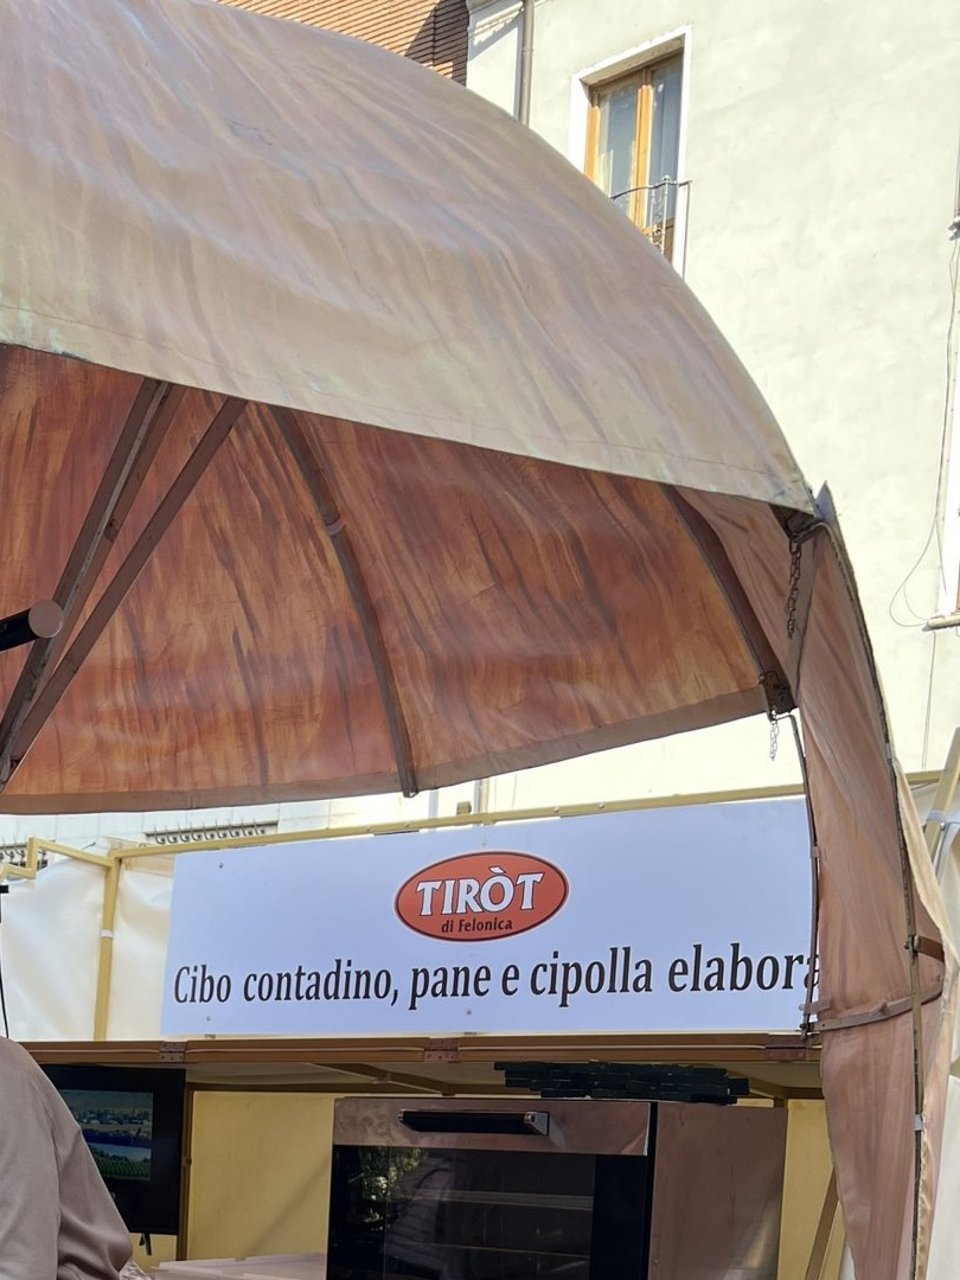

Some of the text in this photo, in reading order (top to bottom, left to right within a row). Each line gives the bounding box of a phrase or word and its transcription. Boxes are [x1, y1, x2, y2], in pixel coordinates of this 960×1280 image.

[416, 865, 545, 916] TIRÒT
[441, 917, 513, 934] di Felonica
[174, 964, 232, 1004] Cibo
[243, 958, 399, 1006] contadino,
[408, 963, 492, 1010] pane
[501, 963, 520, 996] e
[530, 946, 653, 1008] cipolla
